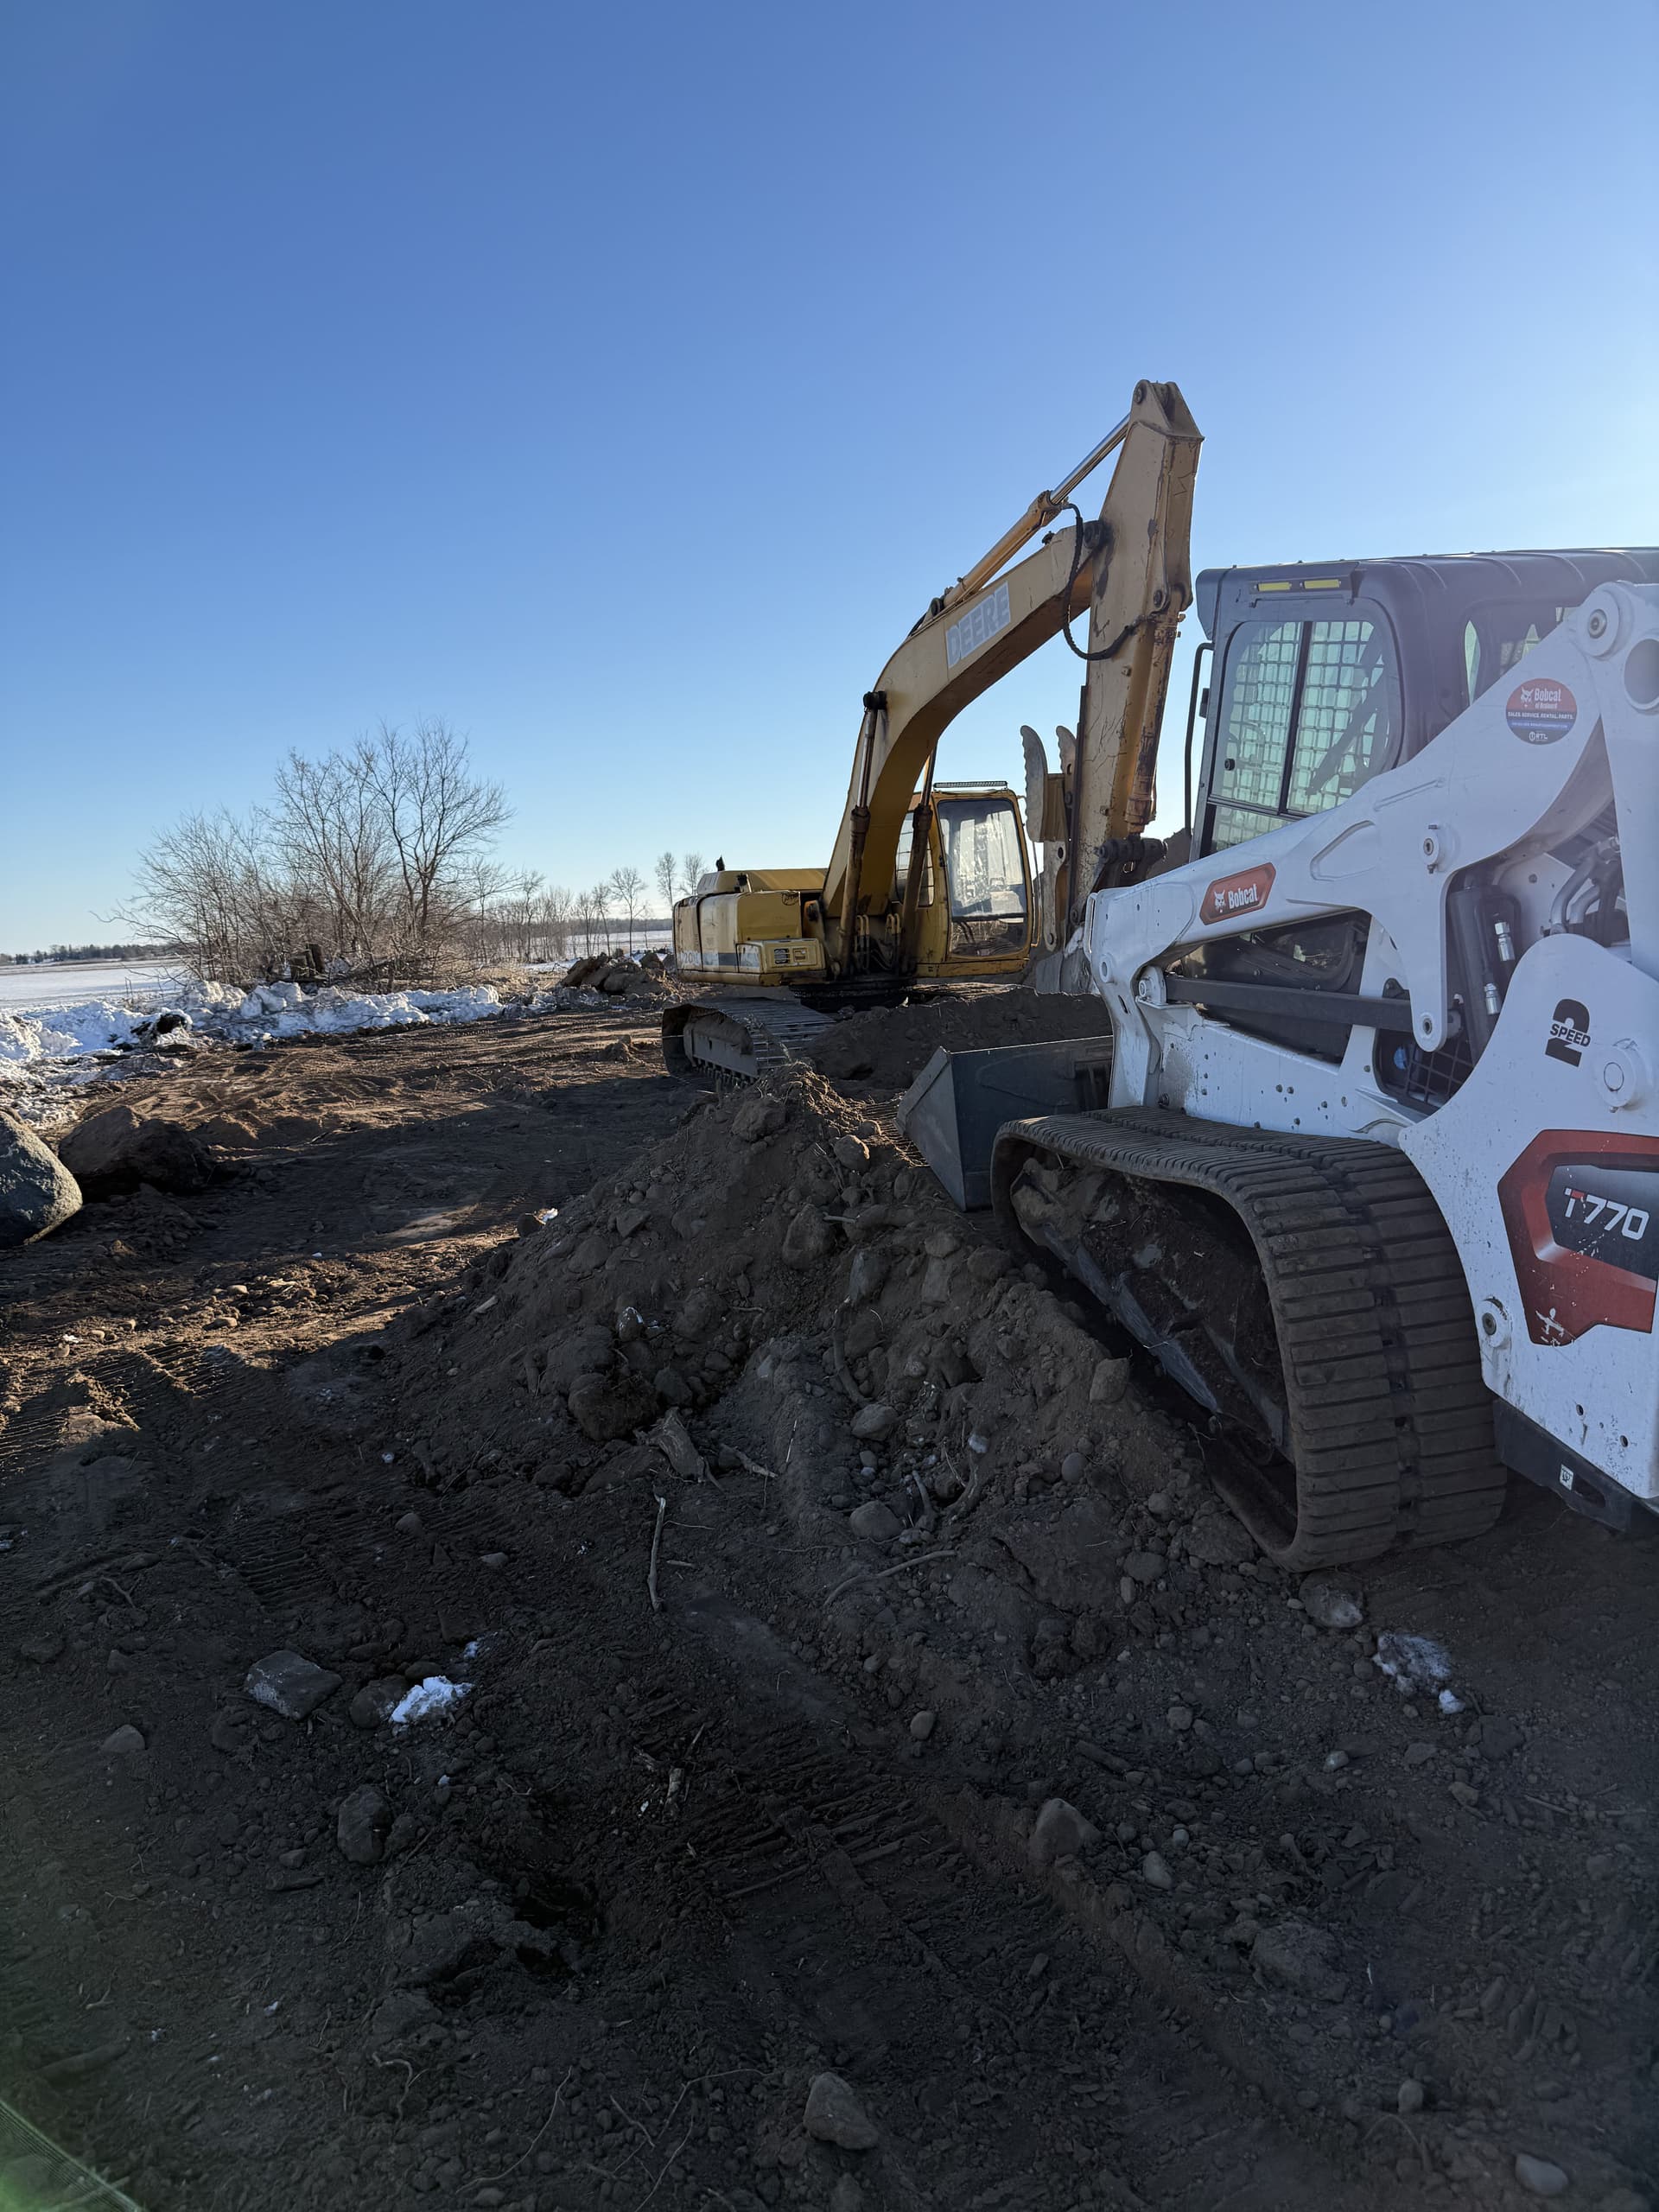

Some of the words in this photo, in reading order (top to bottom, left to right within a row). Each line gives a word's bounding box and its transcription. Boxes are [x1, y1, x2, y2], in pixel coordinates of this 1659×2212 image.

[945, 581, 1011, 668] DEERE
[1534, 687, 1561, 702] Bobcat
[1228, 883, 1258, 909] Bobcat
[1545, 998, 1590, 1068] 2
[1549, 1023, 1592, 1047] SPEED
[1564, 1187, 1649, 1241] T770
